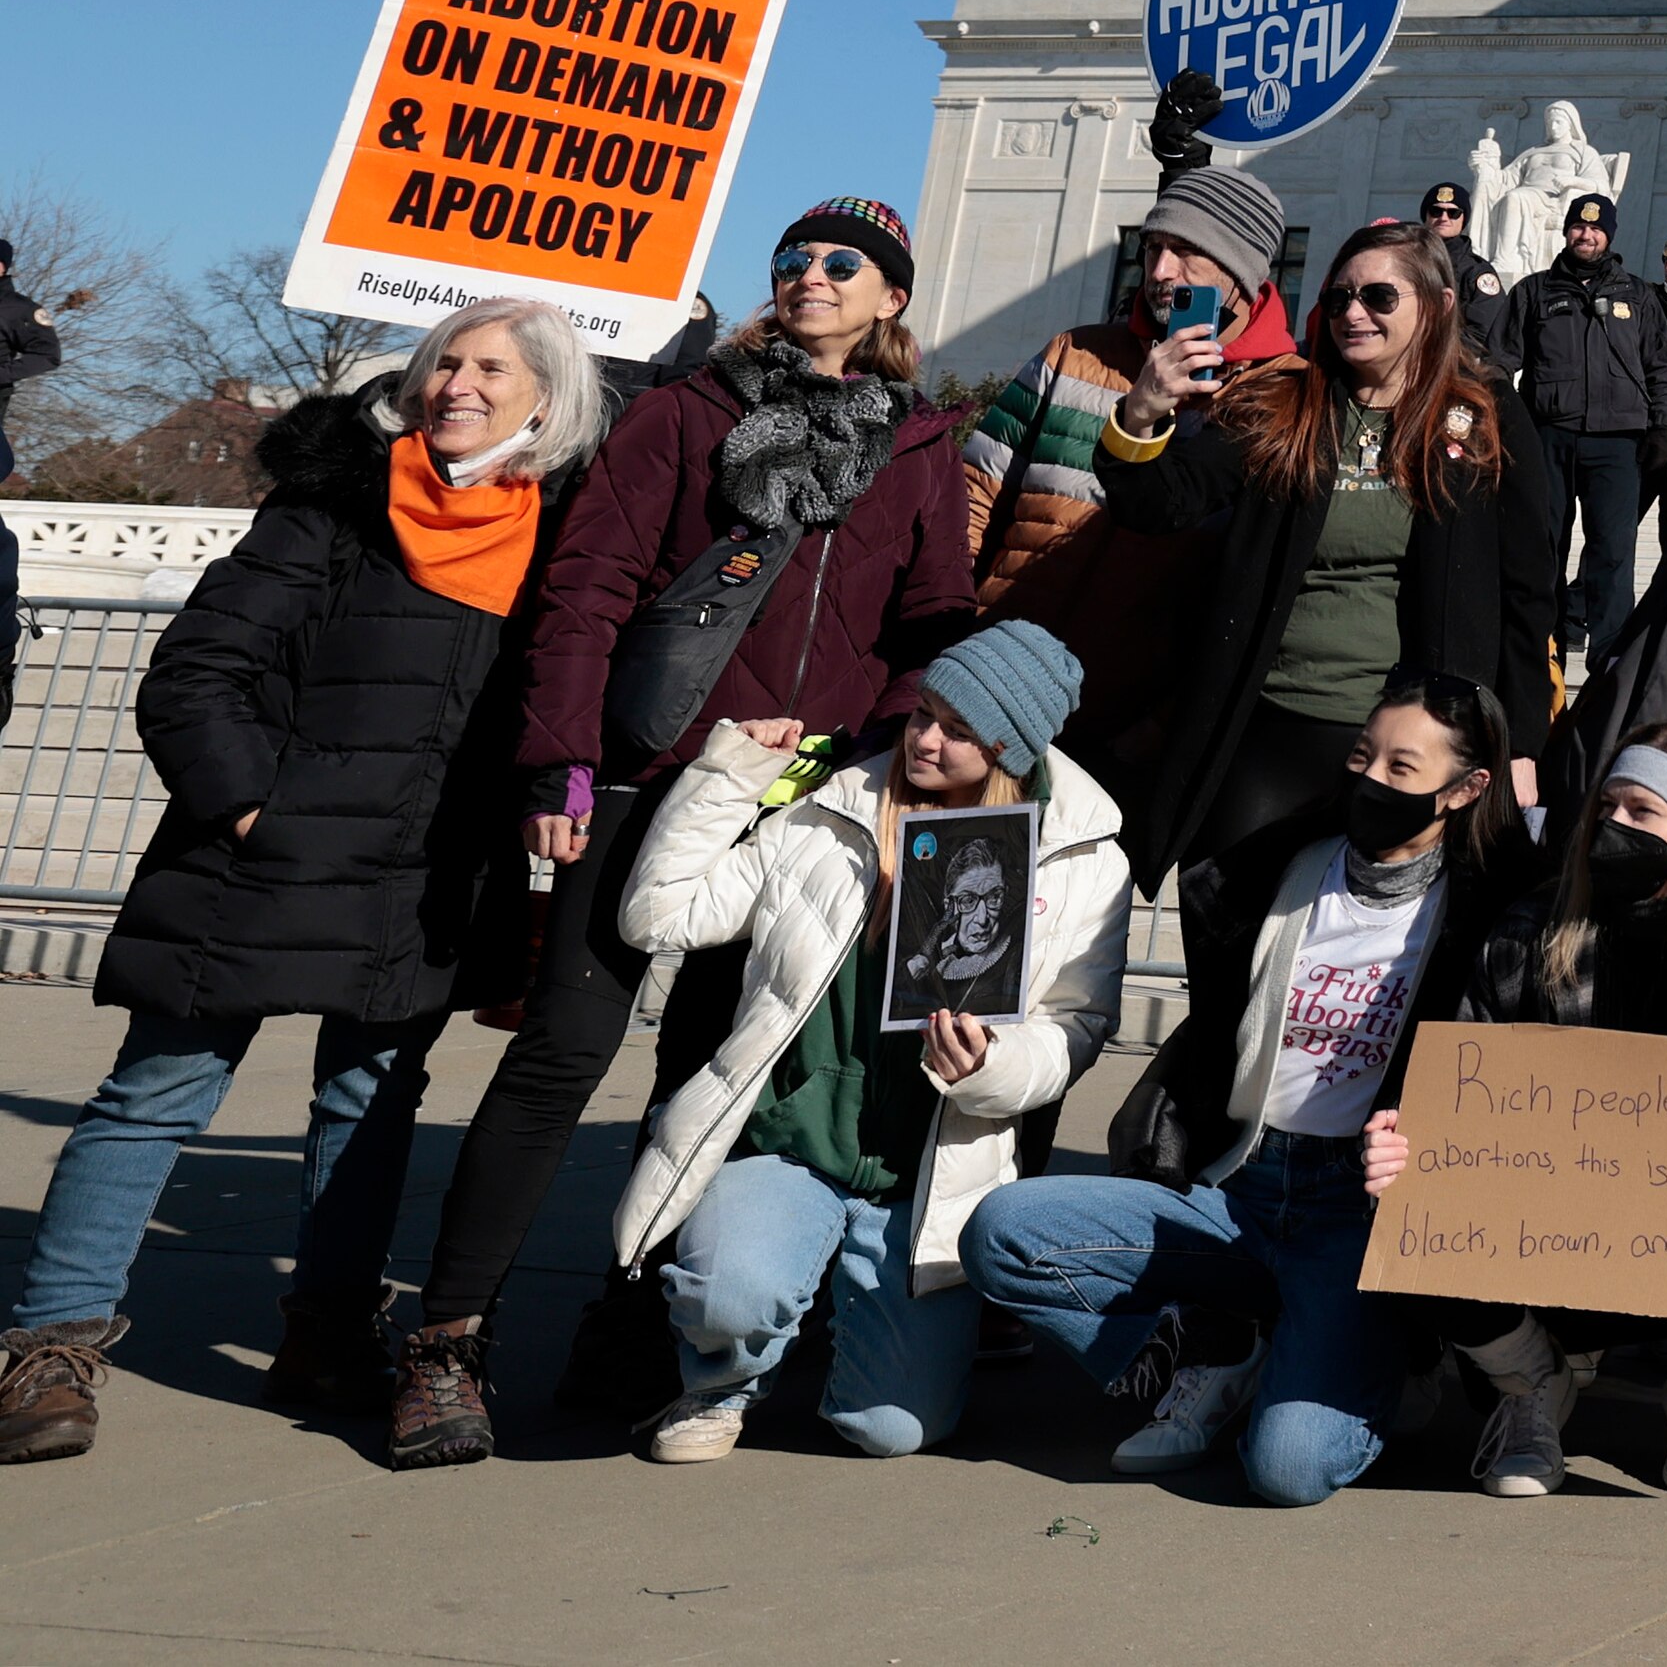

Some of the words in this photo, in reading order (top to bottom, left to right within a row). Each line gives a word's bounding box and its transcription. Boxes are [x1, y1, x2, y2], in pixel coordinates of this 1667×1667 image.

[403, 20, 488, 85] ON
[494, 39, 727, 131] DEMAND
[378, 98, 427, 153] &
[443, 103, 707, 201] WITHOUT
[388, 170, 652, 262] APOLOGY
[1309, 964, 1408, 1010] Fuck
[1290, 1027, 1392, 1067] Bans
[1455, 1041, 1553, 1116] Rich
[1418, 1138, 1556, 1175] abortions,
[1575, 1142, 1621, 1179] this
[1400, 1202, 1497, 1259] black,
[1519, 1219, 1612, 1260] brown,
